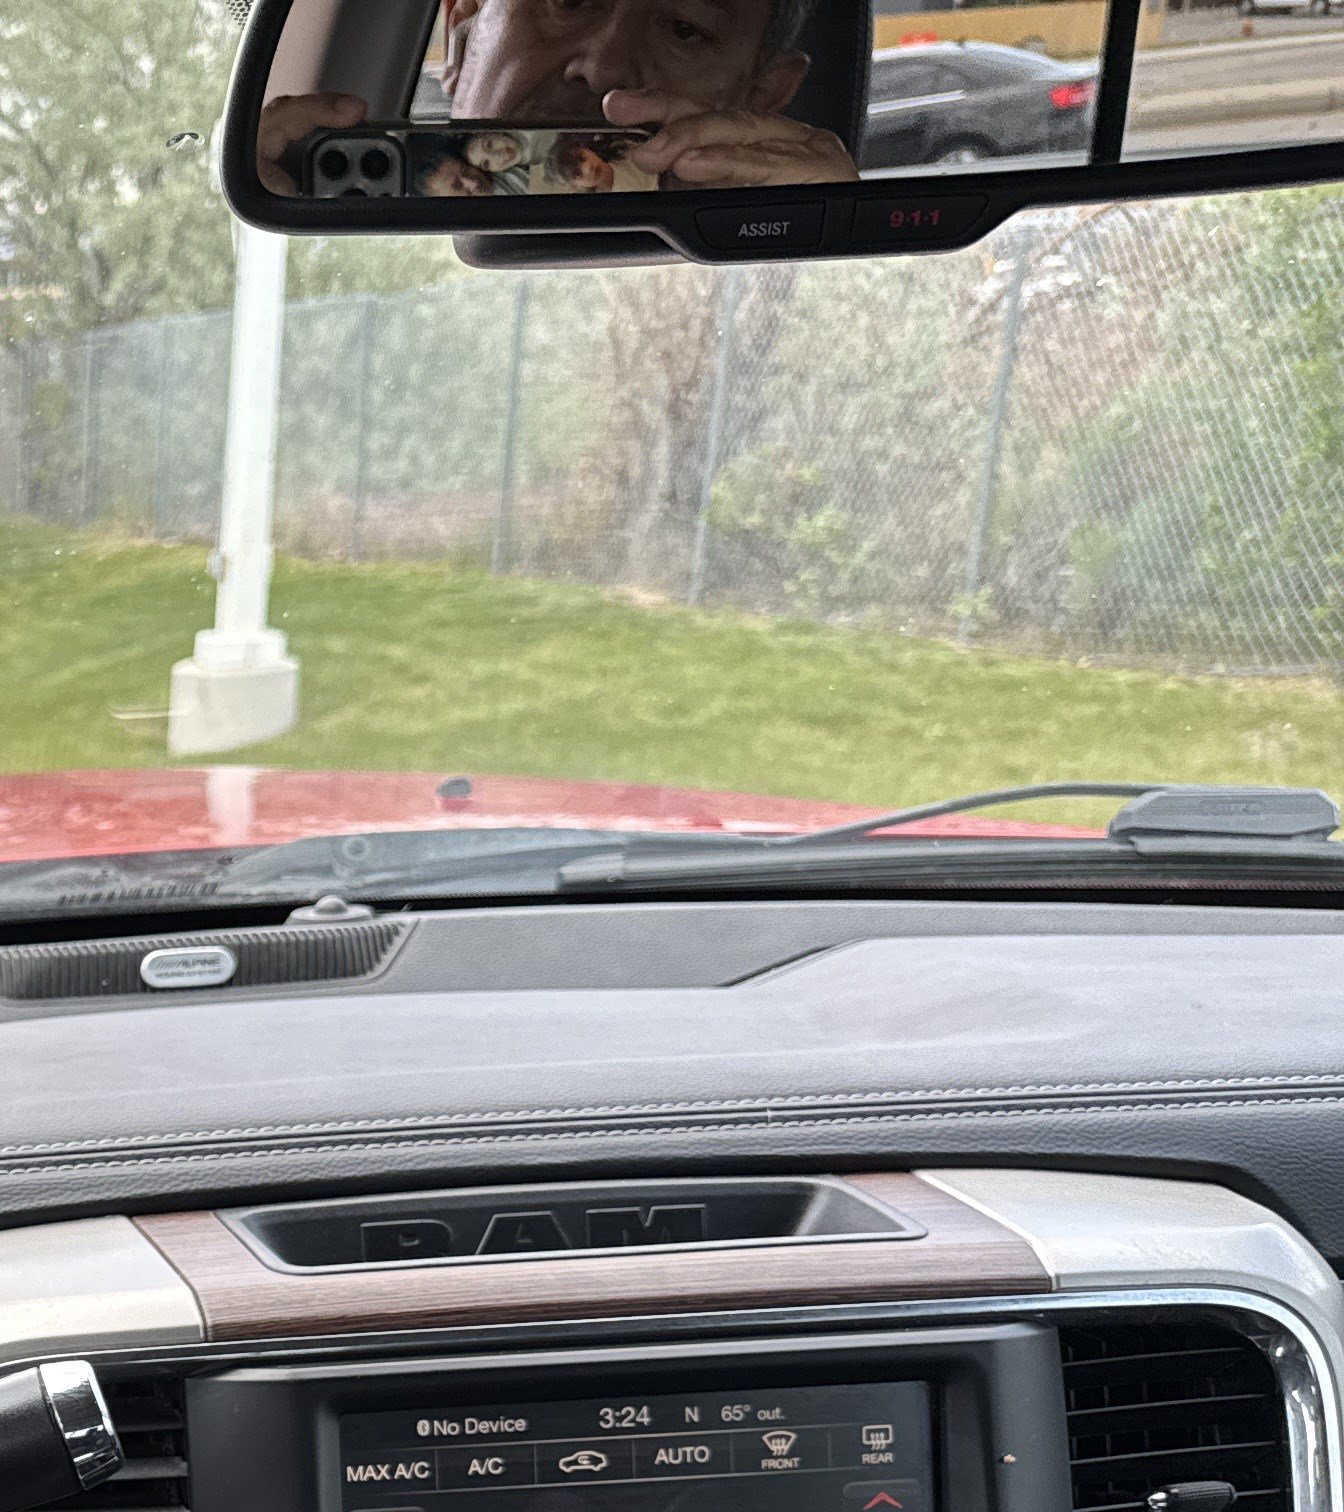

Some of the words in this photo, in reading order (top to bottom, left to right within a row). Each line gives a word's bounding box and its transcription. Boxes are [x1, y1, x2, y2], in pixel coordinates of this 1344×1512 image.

[737, 222, 791, 238] ASSIST
[599, 1406, 652, 1429] 3:24
[684, 1407, 700, 1423] N
[433, 1419, 460, 1437] No
[464, 1416, 528, 1434] Device
[654, 1445, 711, 1465] AUTO
[761, 1457, 801, 1471] FRONT
[861, 1451, 894, 1465] REAR
[346, 1463, 391, 1482] MAX
[393, 1461, 432, 1480] A/C
[467, 1457, 505, 1476] A/C
